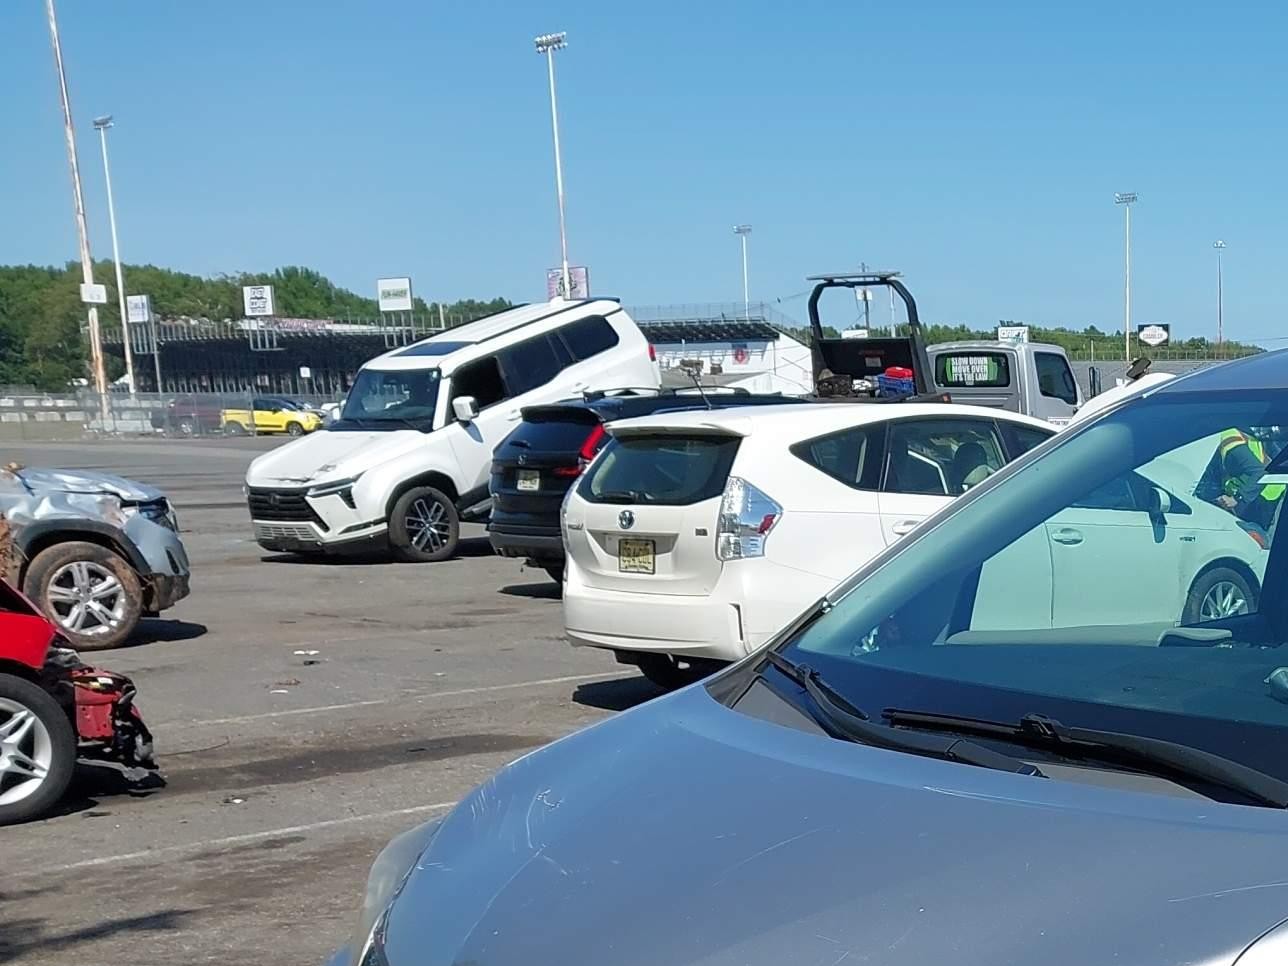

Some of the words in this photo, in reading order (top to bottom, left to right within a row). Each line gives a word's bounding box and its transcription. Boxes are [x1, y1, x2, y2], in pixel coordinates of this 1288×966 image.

[952, 357, 969, 365] SLOW
[970, 357, 988, 365] DOWN
[952, 364, 970, 373] MOVE
[970, 364, 988, 373] OVER
[964, 373, 975, 381] THE
[974, 373, 988, 381] LAW
